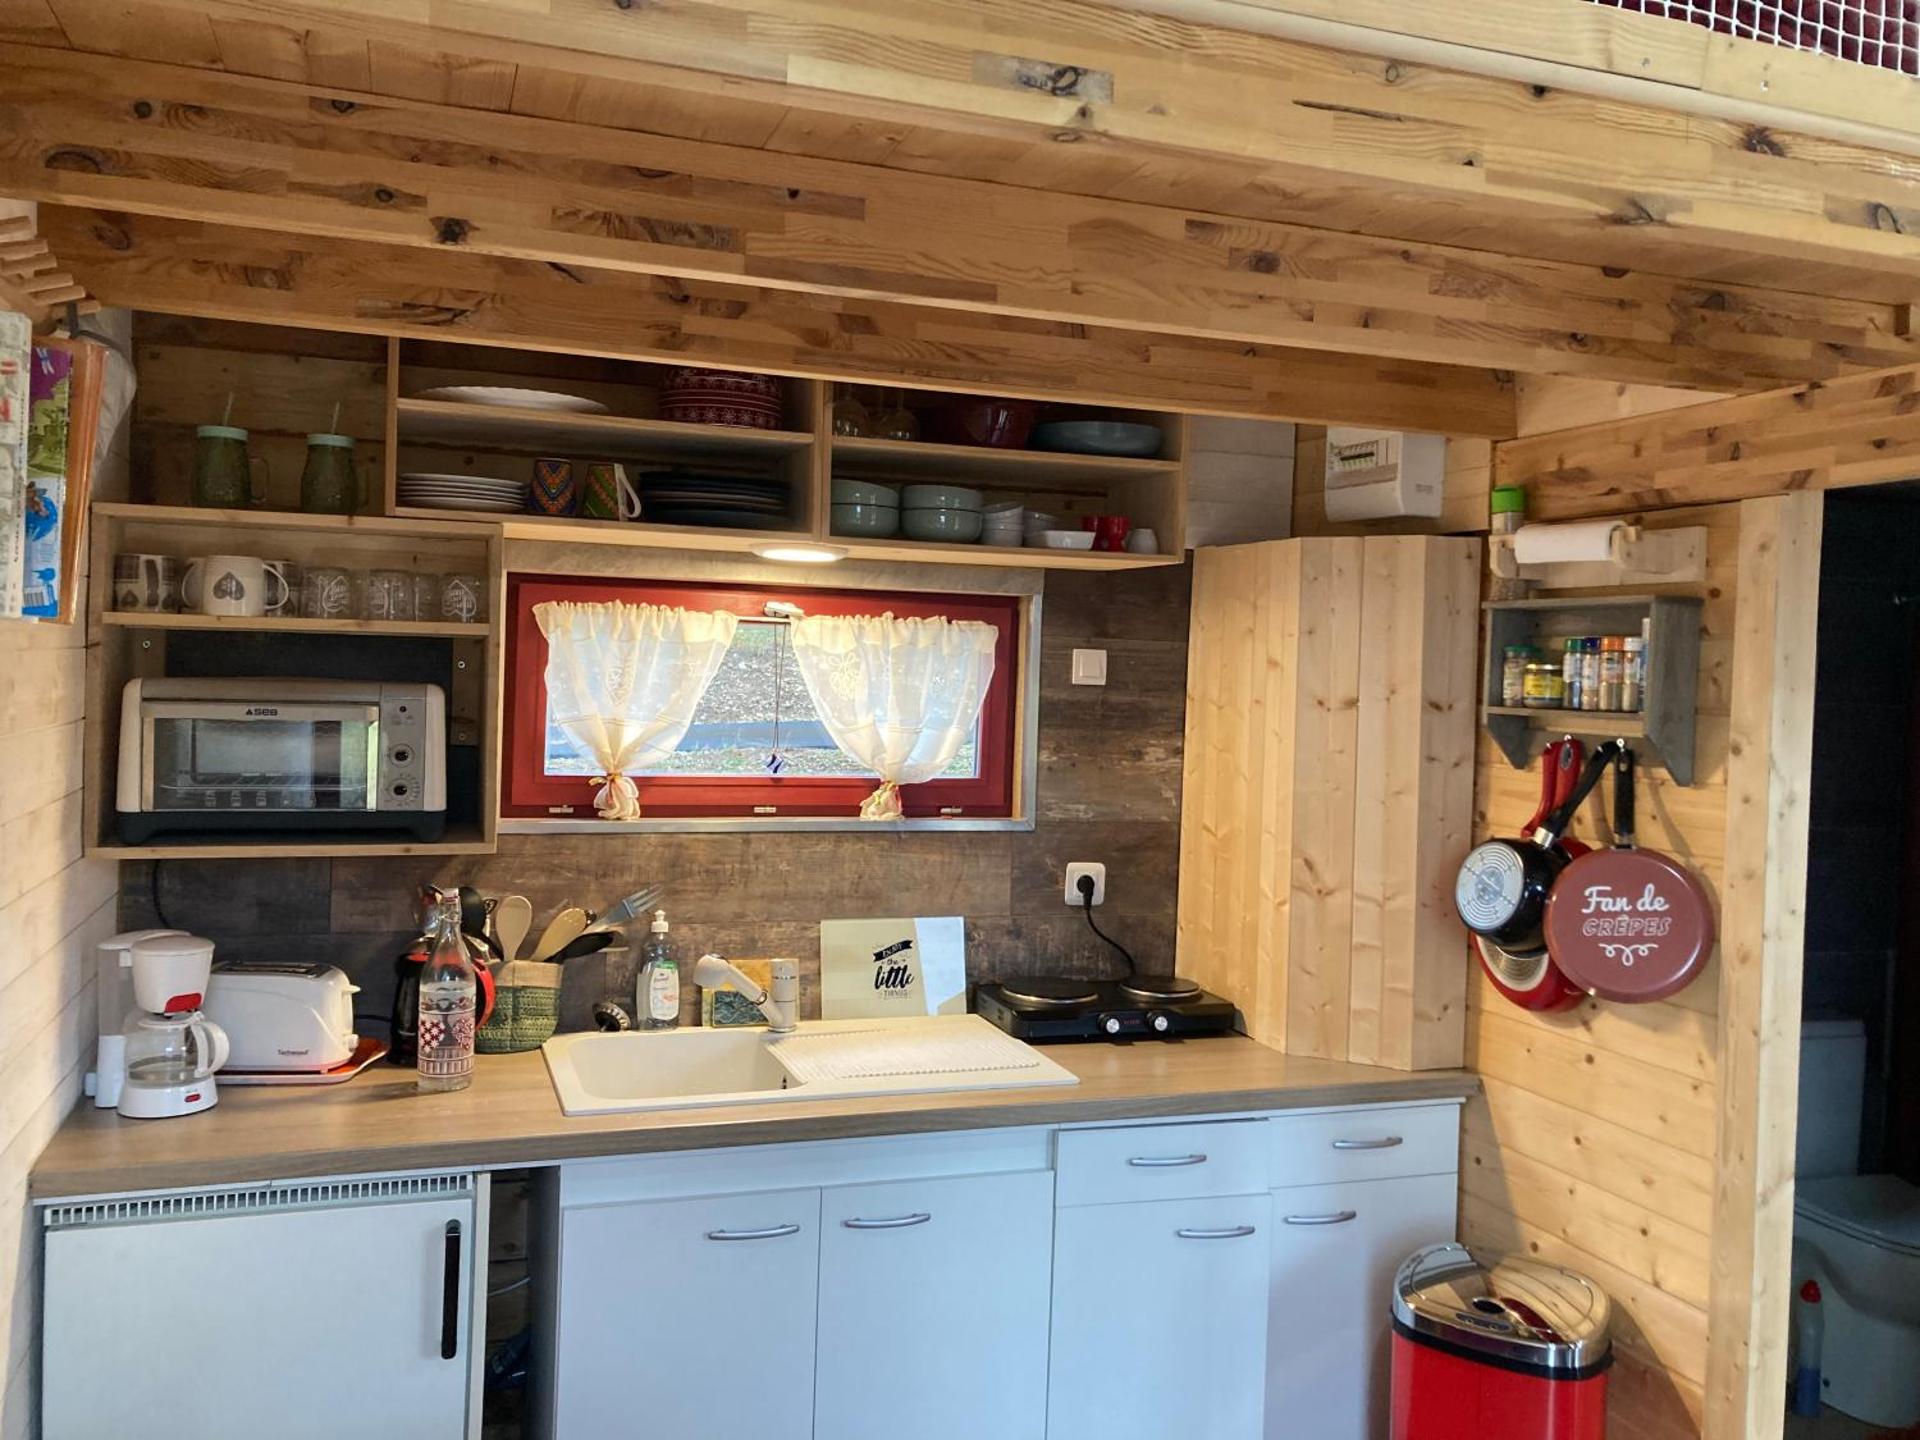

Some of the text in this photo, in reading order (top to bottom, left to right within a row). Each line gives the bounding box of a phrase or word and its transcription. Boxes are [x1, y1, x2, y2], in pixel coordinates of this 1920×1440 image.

[1581, 882, 1669, 913] Fan de
[1582, 914, 1672, 937] CRÊPES
[874, 964, 915, 990] little
